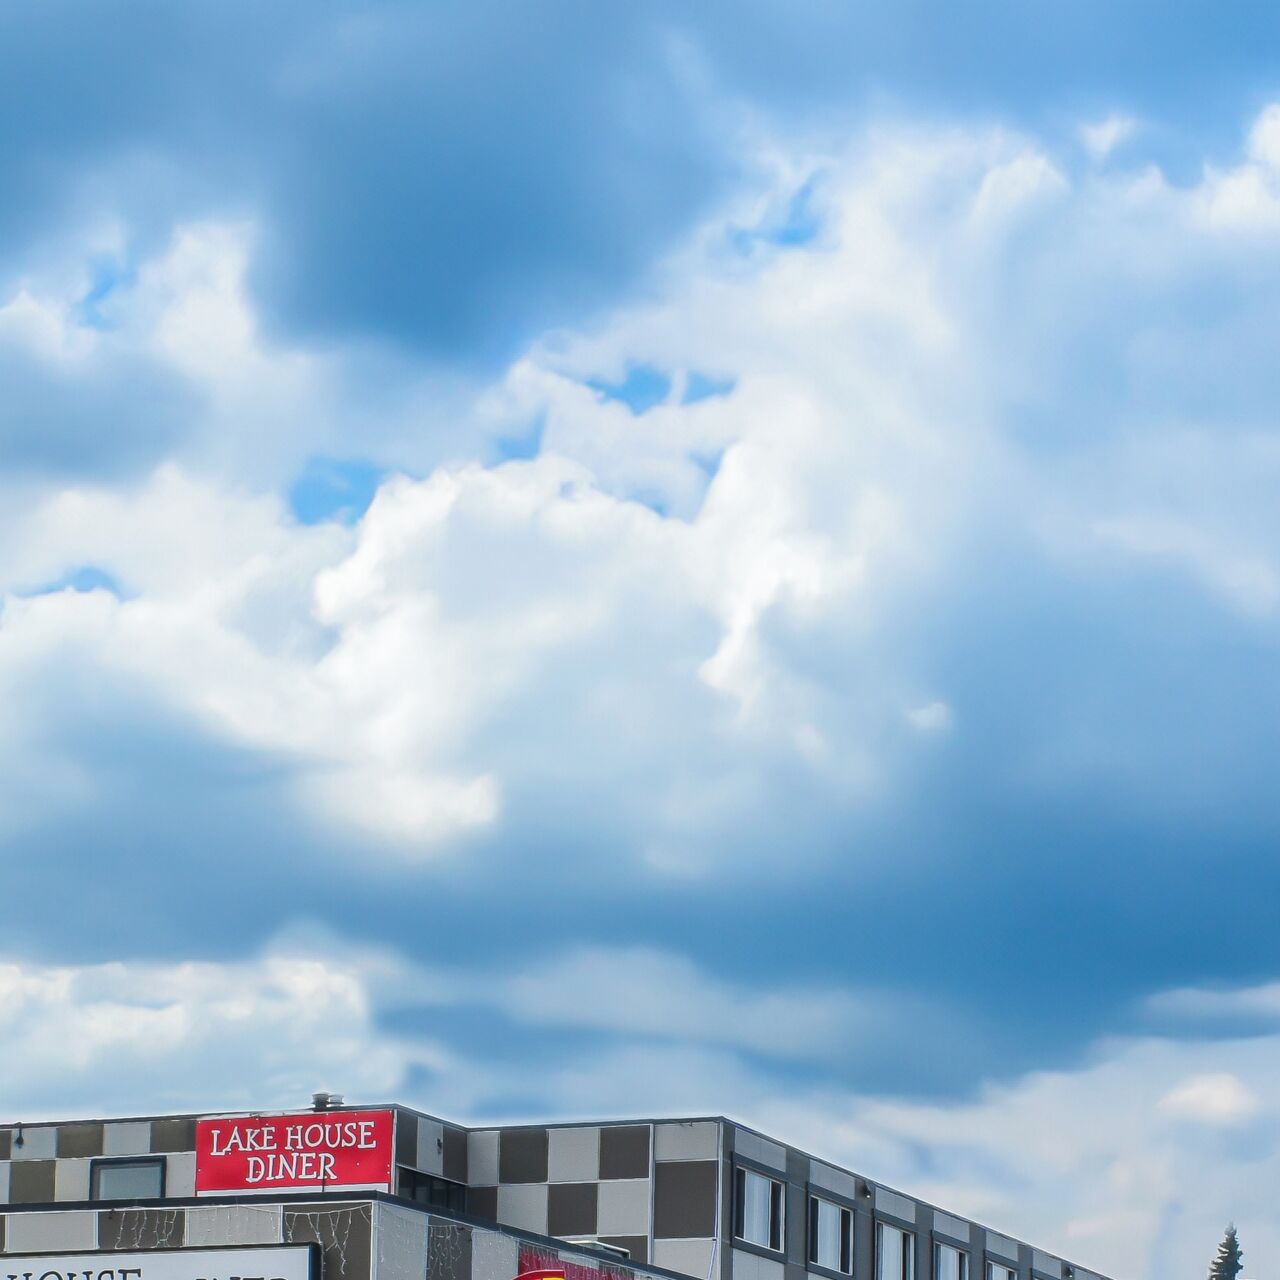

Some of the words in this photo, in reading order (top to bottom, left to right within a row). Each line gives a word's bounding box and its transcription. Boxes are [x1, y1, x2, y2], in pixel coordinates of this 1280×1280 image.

[210, 1126, 277, 1156] LAKE
[285, 1121, 377, 1150] HOUSE
[245, 1152, 337, 1183] DINER
